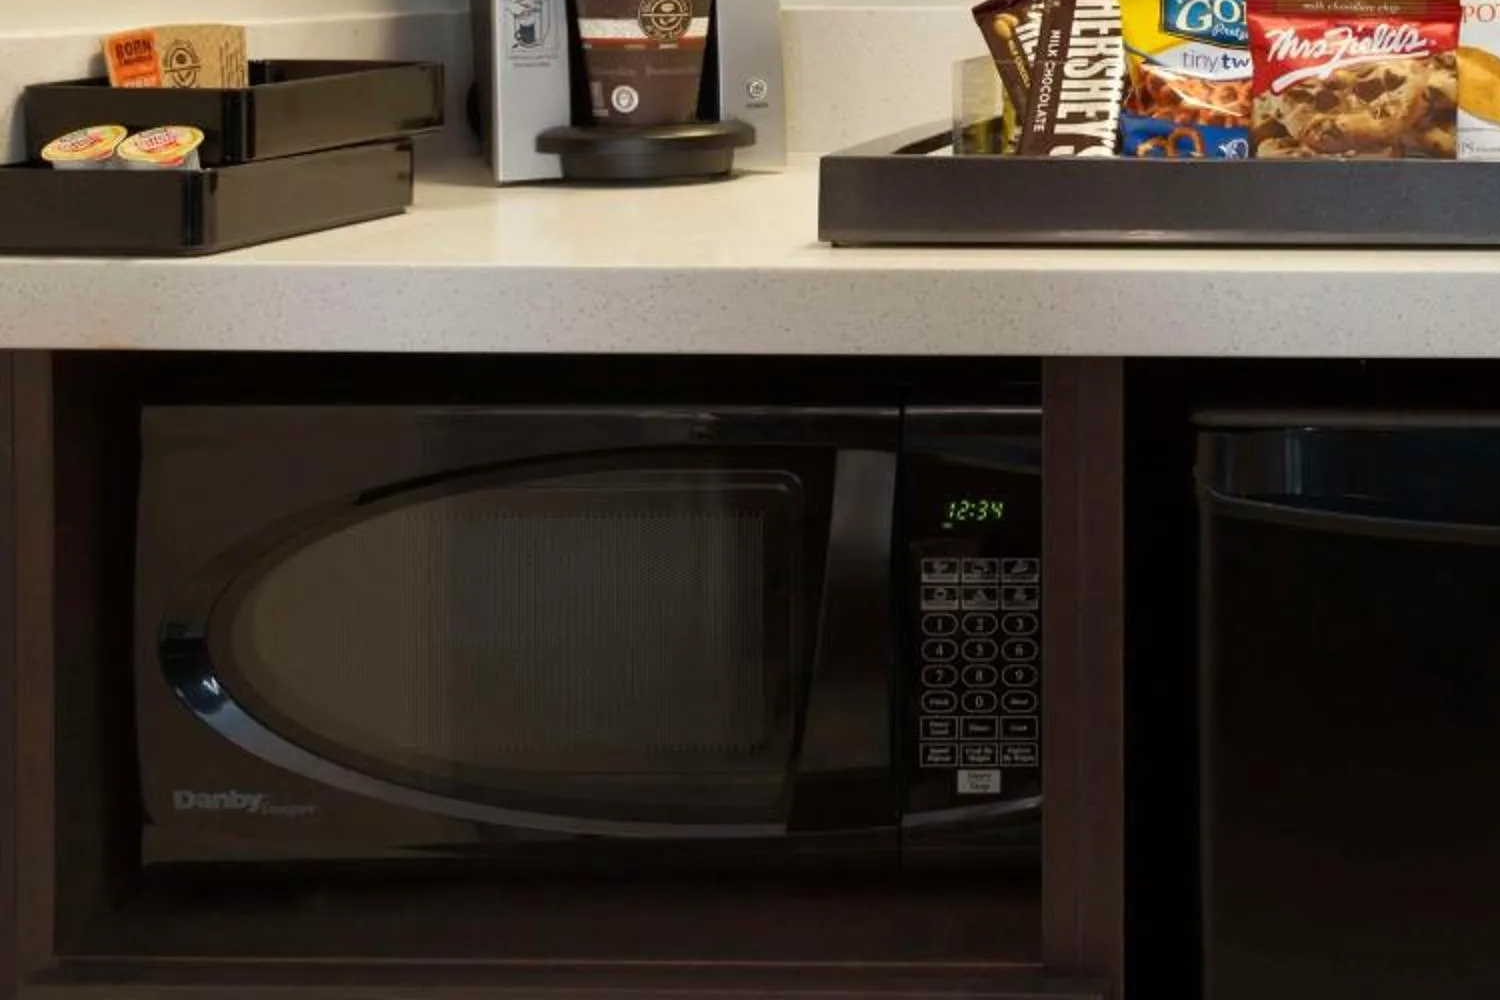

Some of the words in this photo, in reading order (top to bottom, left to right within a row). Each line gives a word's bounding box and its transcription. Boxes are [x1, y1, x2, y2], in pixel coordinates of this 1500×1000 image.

[1302, 0, 1325, 10] milk
[1327, 0, 1375, 13] chocolate
[1378, 1, 1401, 14] chip
[115, 39, 153, 60] BORN
[1047, 29, 1062, 57] MILK
[1183, 50, 1218, 73] tiny
[1221, 53, 1249, 69] tw
[1033, 60, 1056, 133] CHOCOLATE
[948, 499, 1005, 521] 12:34
[172, 788, 267, 814] Danby
